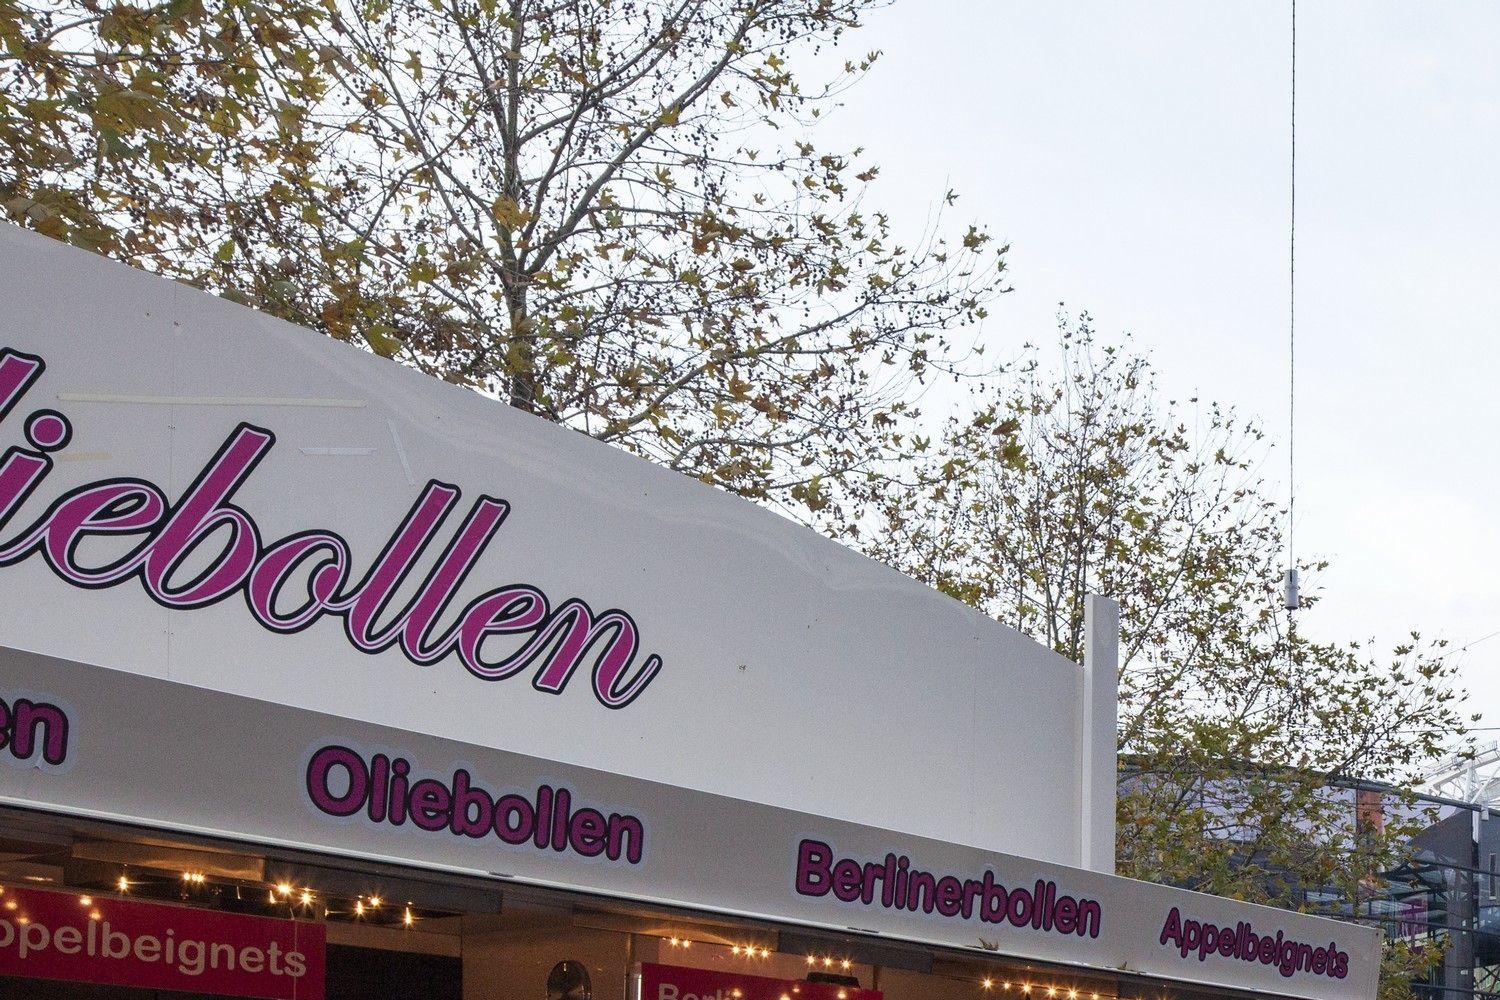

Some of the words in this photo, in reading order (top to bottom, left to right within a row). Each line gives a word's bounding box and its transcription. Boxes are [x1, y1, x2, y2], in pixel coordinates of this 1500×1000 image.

[306, 745, 644, 865] Oliebollen
[795, 838, 1102, 939] Berlinerbollen
[1159, 906, 1350, 981] Appelbeignets
